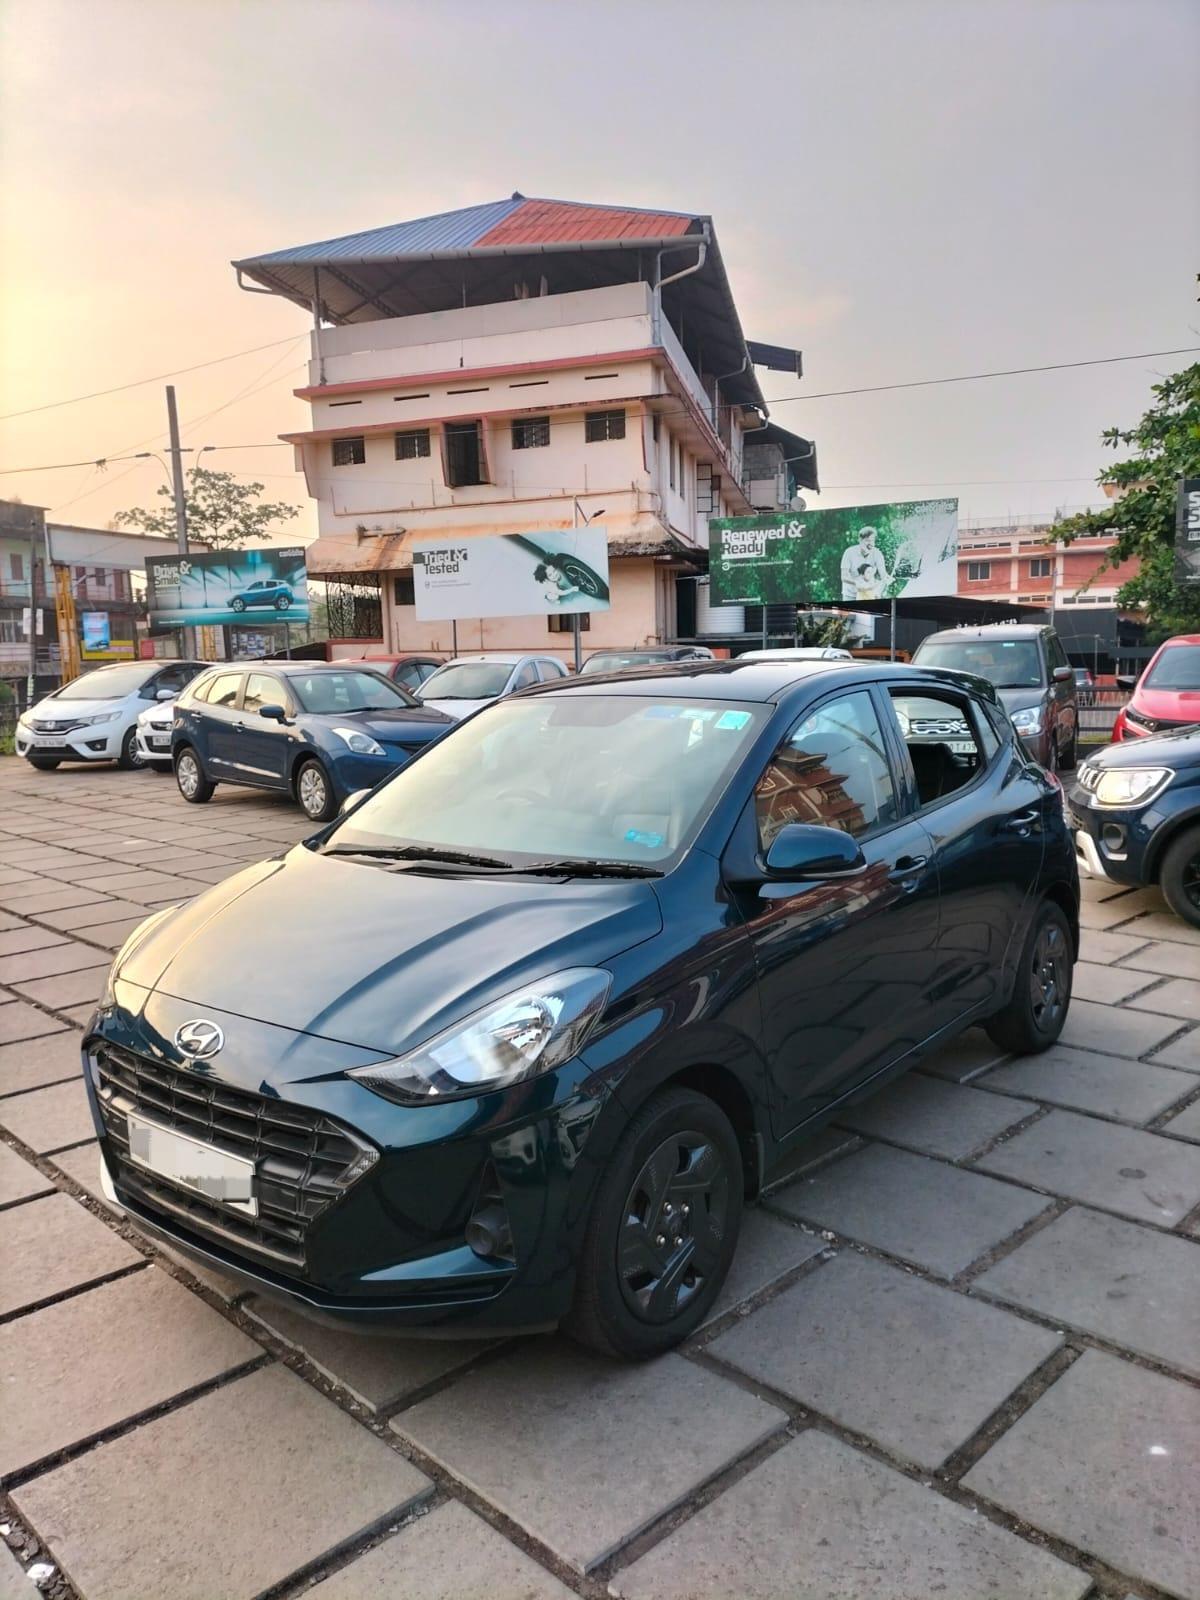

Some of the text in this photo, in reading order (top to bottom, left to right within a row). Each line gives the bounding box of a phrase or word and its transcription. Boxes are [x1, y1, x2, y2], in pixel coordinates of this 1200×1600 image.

[721, 520, 806, 543] Renewed &
[422, 548, 468, 564] Tried &
[722, 540, 764, 556] Ready
[153, 560, 191, 578] Drive &
[423, 562, 460, 574] Tested
[154, 575, 180, 586] Smile
